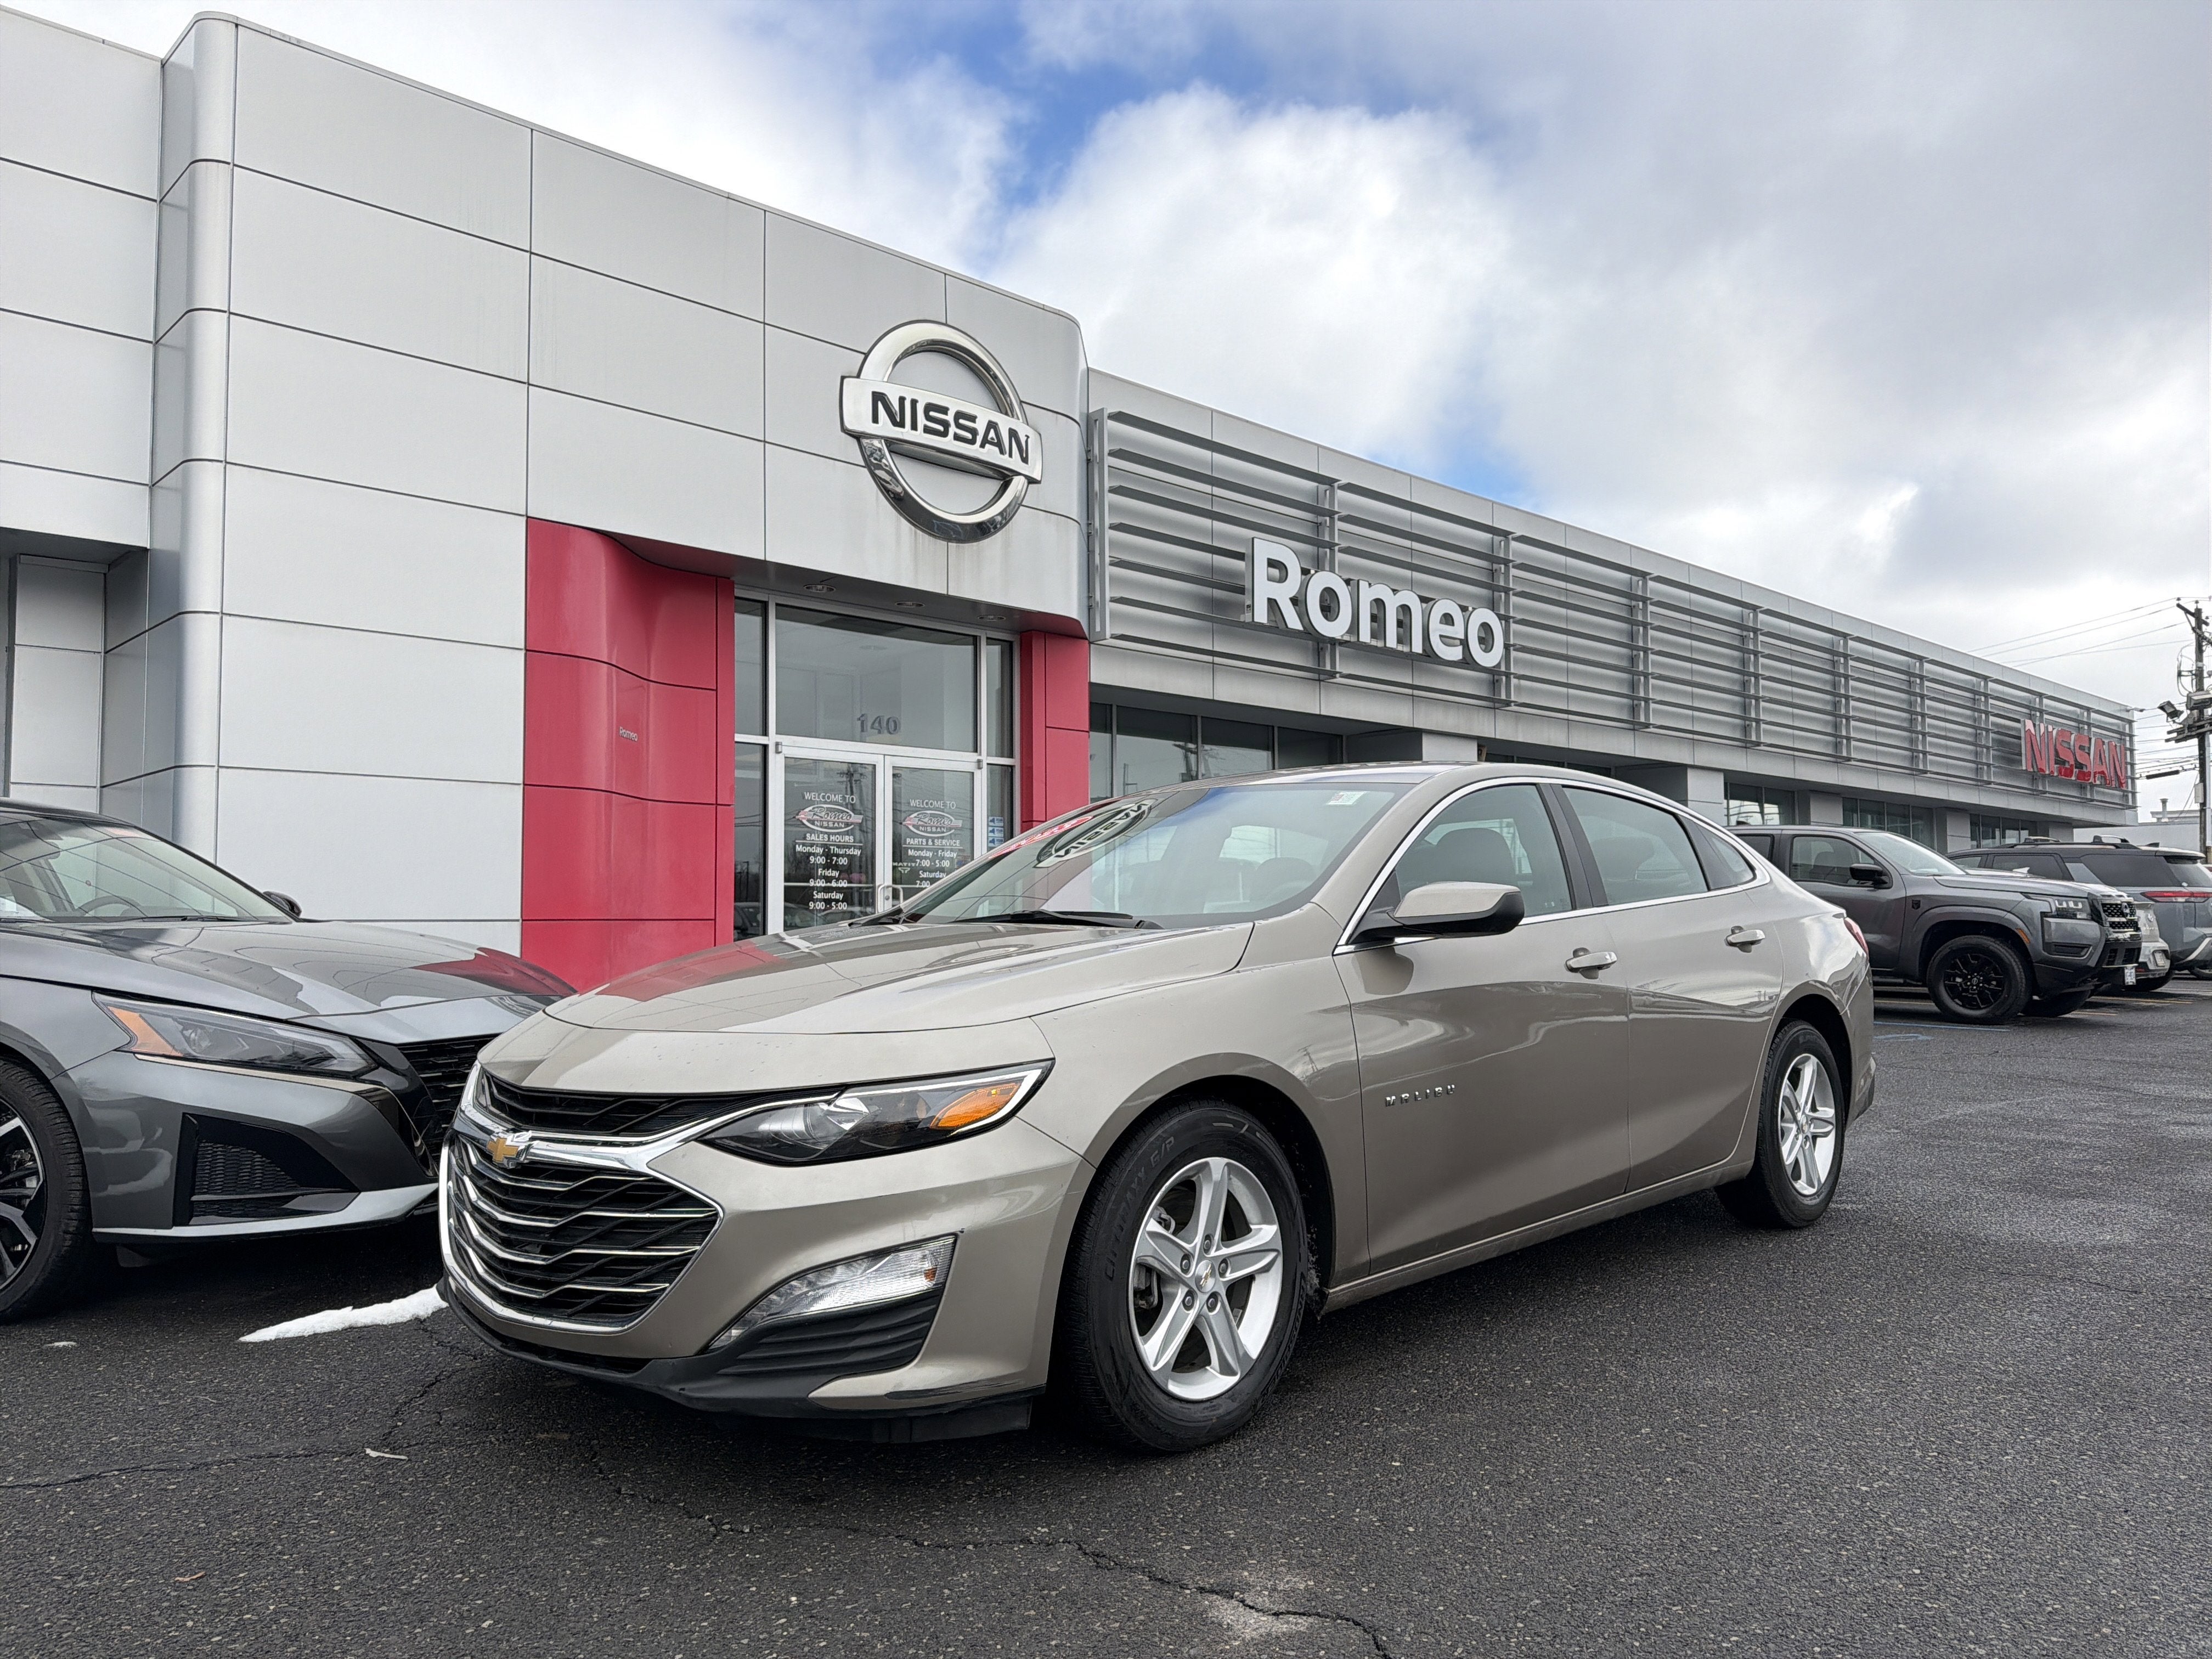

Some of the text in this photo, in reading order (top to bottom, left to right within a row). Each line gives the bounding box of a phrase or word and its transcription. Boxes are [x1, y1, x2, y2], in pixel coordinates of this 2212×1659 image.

[871, 390, 1030, 465] NISSAN
[1250, 536, 1504, 668] Romeo
[857, 713, 901, 735] 140
[619, 726, 638, 742] Romeo
[2022, 719, 2126, 789] NISSAN
[804, 792, 856, 804] WELCOME TO
[910, 799, 956, 809] WELCOME TO
[811, 806, 852, 820] Romeo
[916, 812, 952, 825] Romeo
[806, 833, 828, 842] SALES
[795, 844, 823, 854] Monday
[830, 846, 861, 856] Thursday
[908, 849, 933, 857] Monday
[938, 850, 957, 859] Friday
[809, 856, 826, 864] 9:00
[818, 868, 839, 878] Friday
[813, 890, 843, 900] Saturday
[809, 901, 825, 910] 9:00
[832, 902, 848, 910] 5:00
[1385, 1084, 1455, 1107] MALIBU
